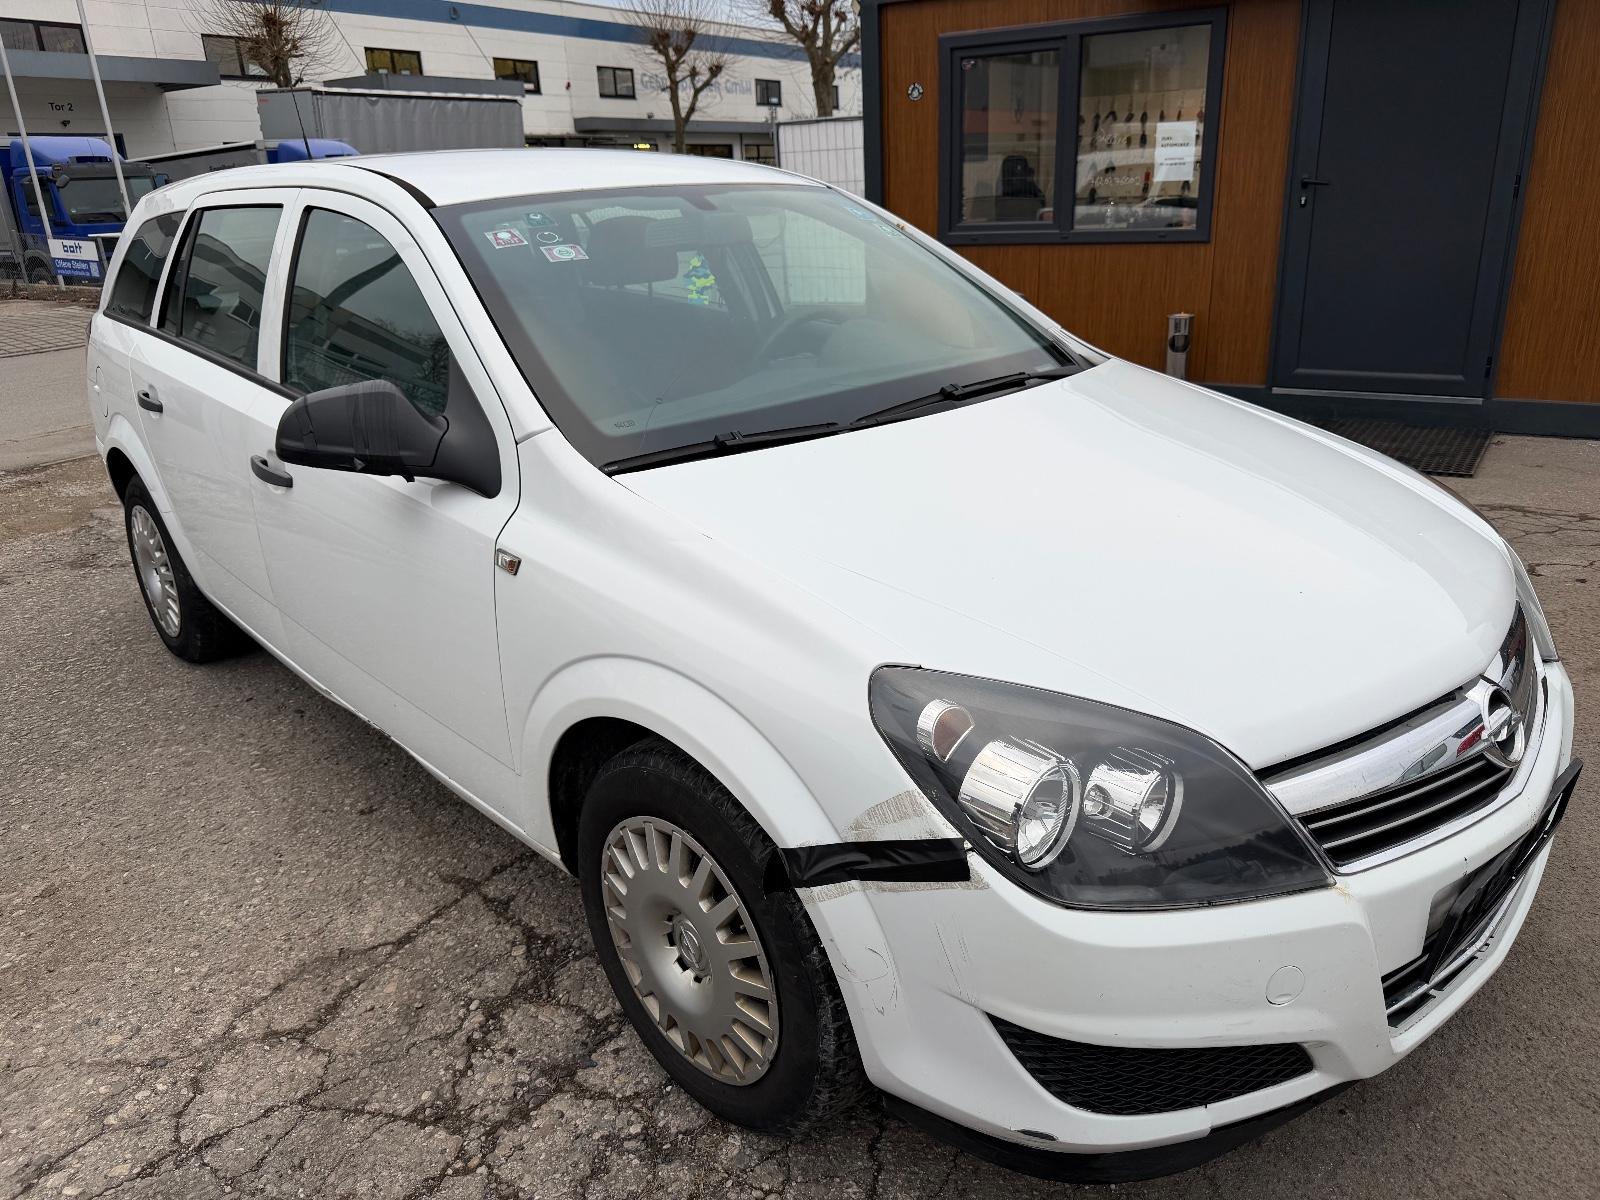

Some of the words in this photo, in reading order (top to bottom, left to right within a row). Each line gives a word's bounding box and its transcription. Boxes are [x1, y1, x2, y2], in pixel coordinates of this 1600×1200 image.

[48, 102, 65, 111] Tor
[67, 102, 74, 111] 2
[61, 241, 82, 254] bott
